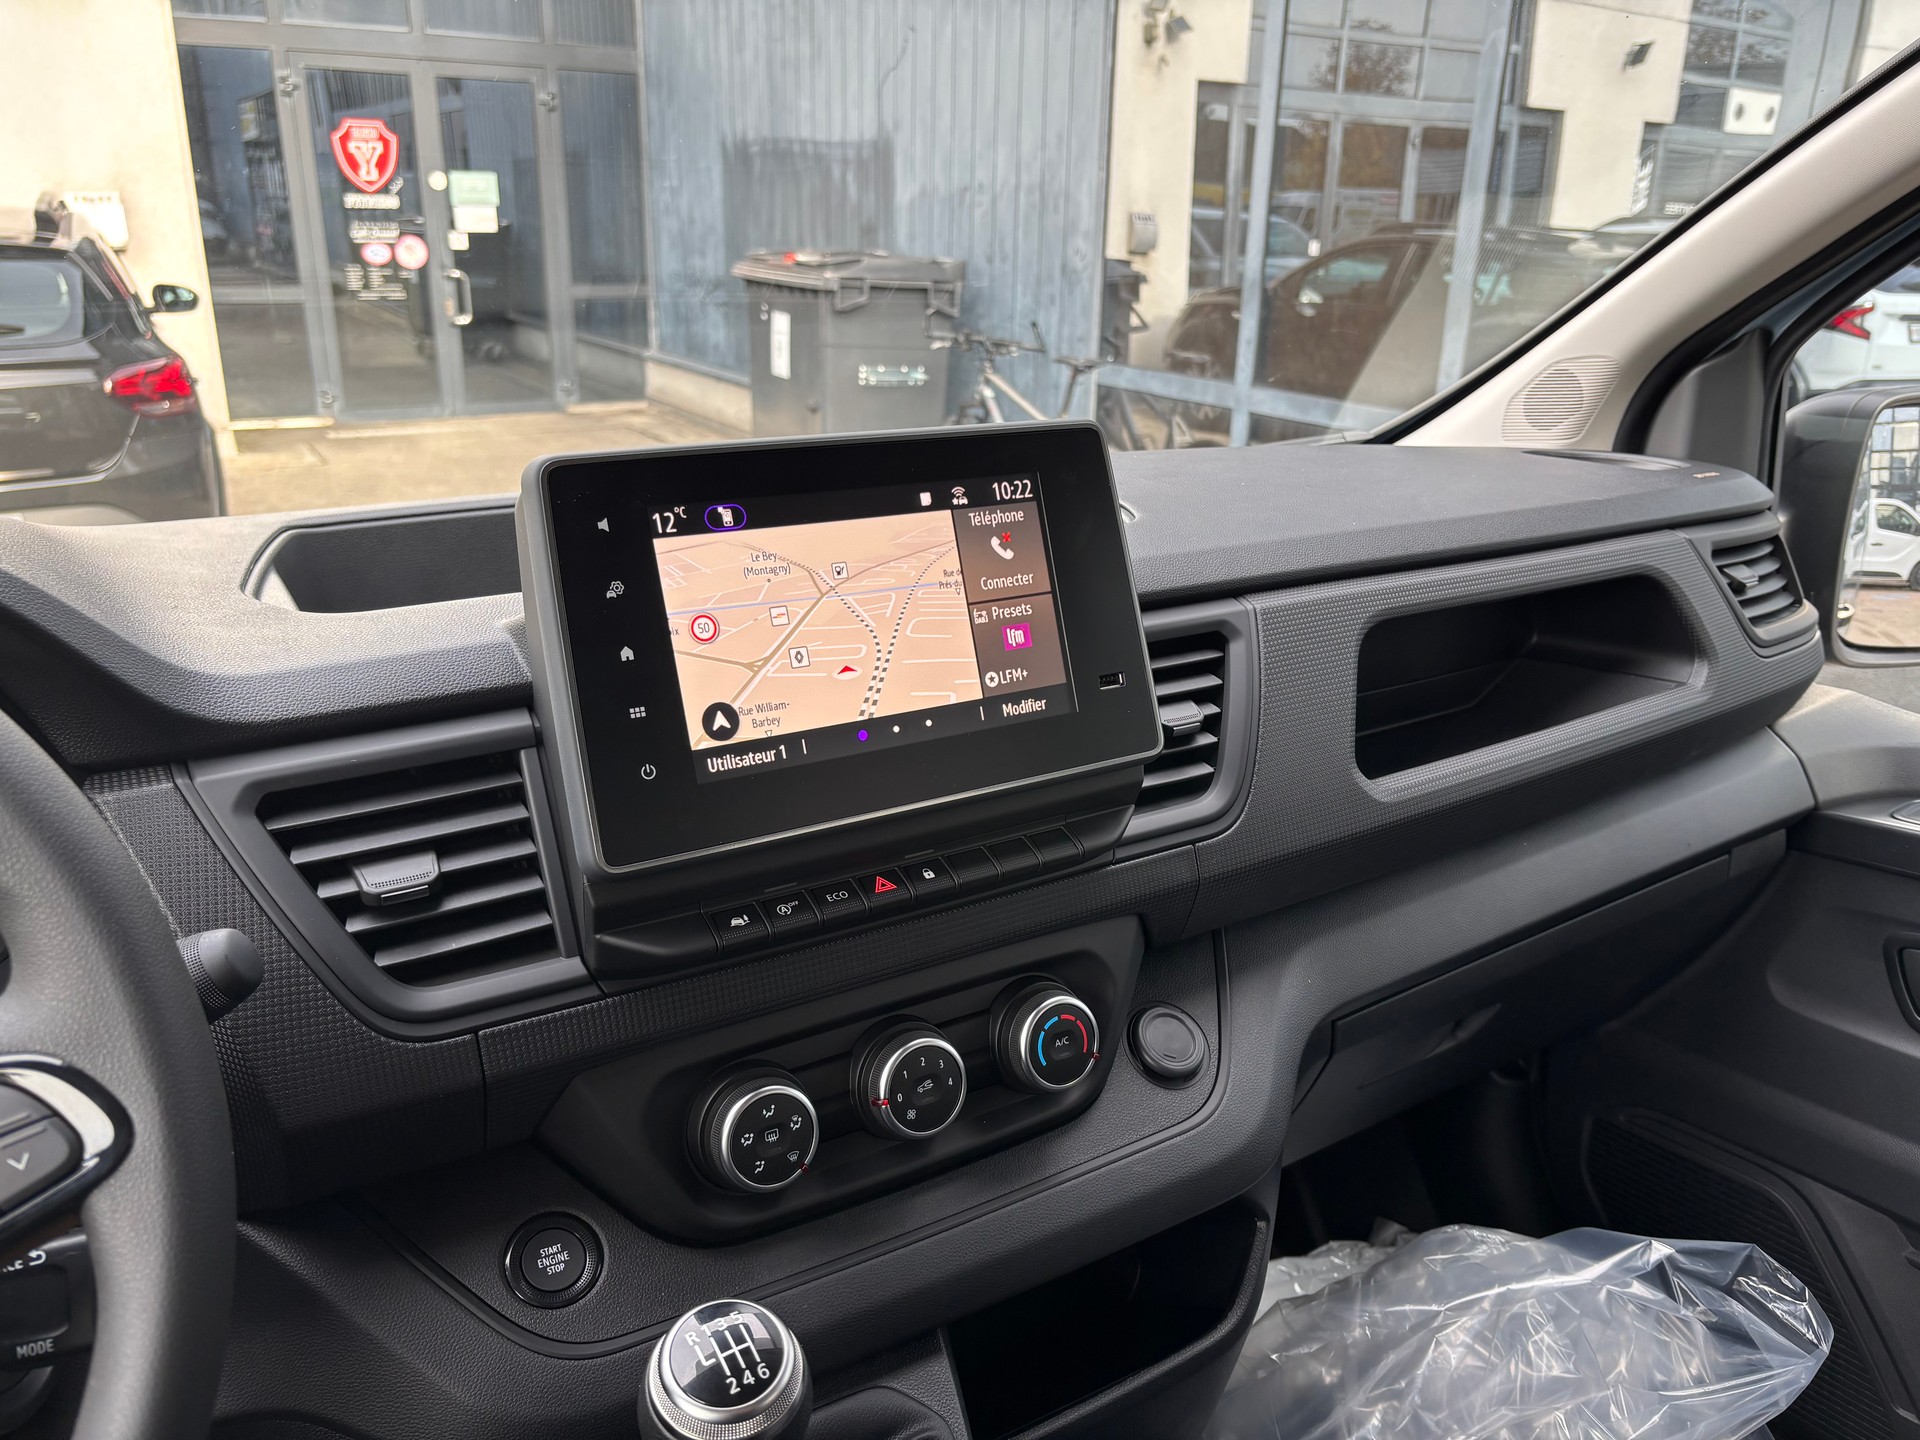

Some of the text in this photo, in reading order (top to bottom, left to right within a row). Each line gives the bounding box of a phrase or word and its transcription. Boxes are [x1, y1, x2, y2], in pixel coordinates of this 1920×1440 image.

[992, 479, 1033, 501] 10:22
[968, 510, 1024, 527] Téléphone
[751, 551, 778, 562] Le Bey
[743, 563, 791, 579] (Montagny)
[943, 569, 954, 577] Rue
[980, 573, 1034, 590] Connecter
[991, 603, 1033, 620] Presets
[697, 622, 710, 634] 50
[999, 667, 1029, 684] LFM+
[738, 701, 790, 717] Rue William-
[1002, 698, 1046, 717] Modifier
[752, 716, 781, 729] Barbey
[707, 744, 787, 773] Utilisateur 1
[826, 890, 849, 902] ECO
[1055, 1036, 1069, 1047] A/C
[540, 1243, 561, 1257] START
[537, 1250, 570, 1268] ENGINE
[547, 1262, 565, 1275] STOP
[684, 1311, 743, 1346] R 1 3 5
[16, 1338, 55, 1359] MODE
[725, 1362, 770, 1395] 2 4 6
